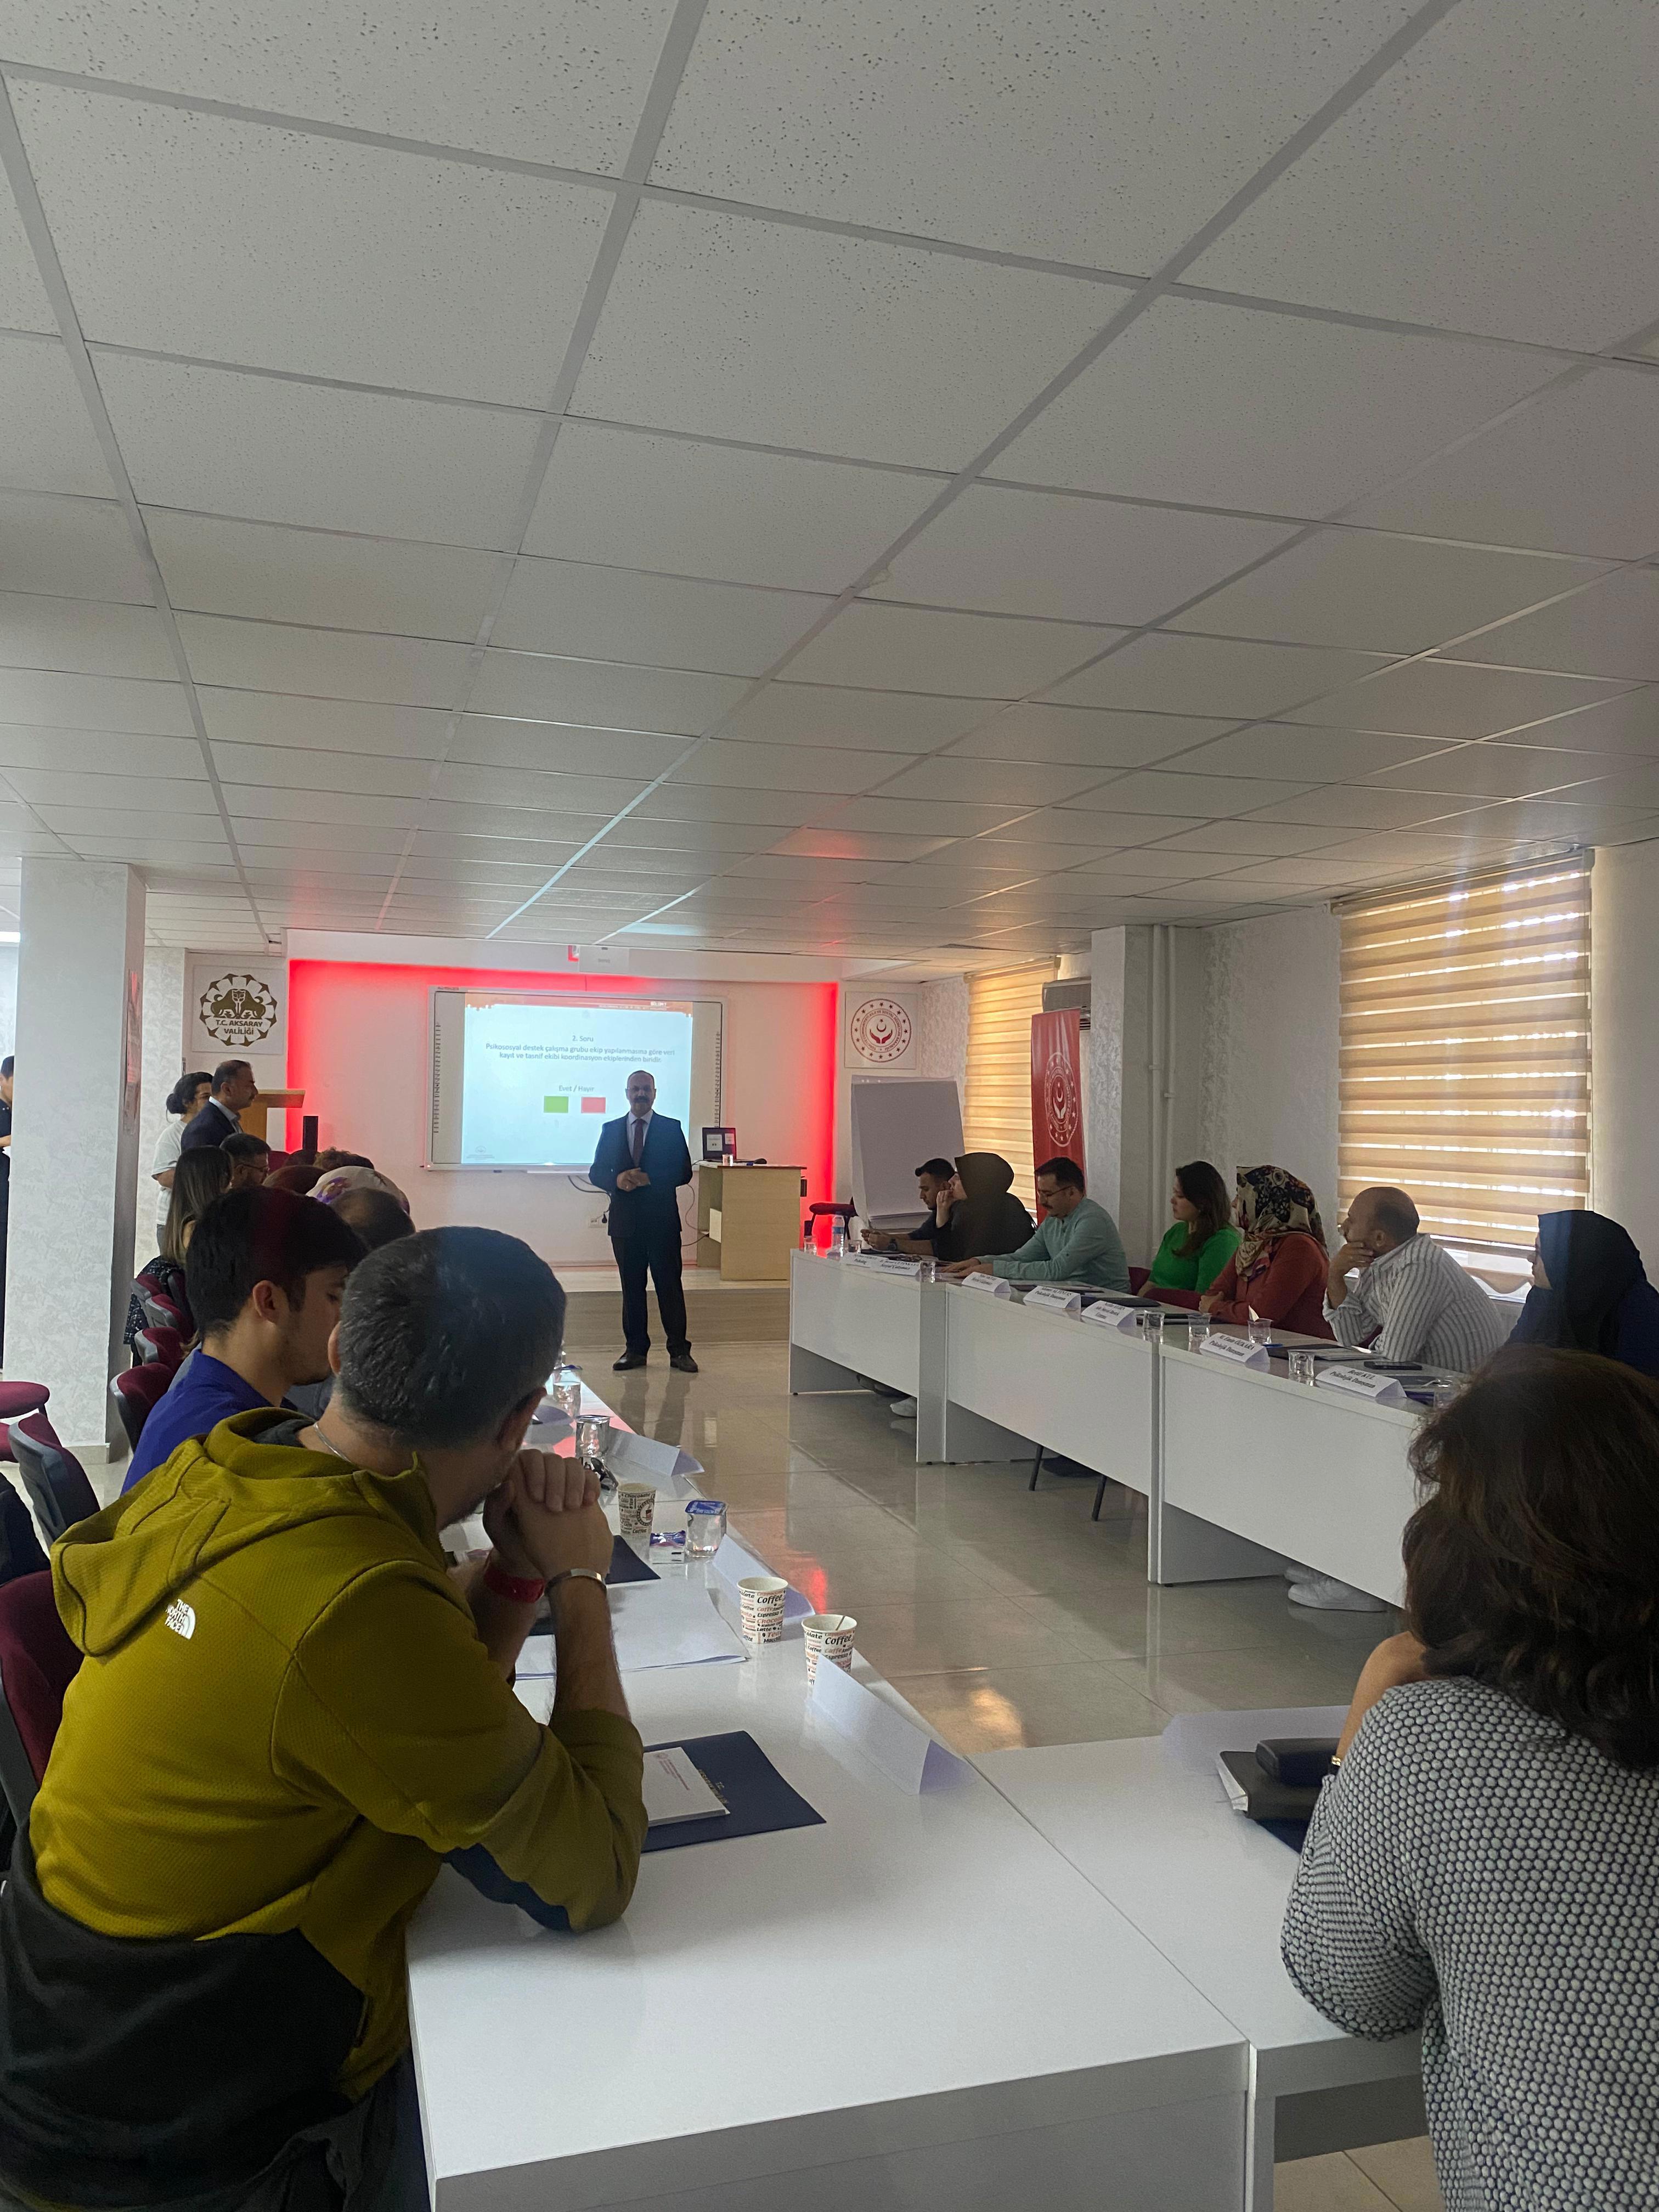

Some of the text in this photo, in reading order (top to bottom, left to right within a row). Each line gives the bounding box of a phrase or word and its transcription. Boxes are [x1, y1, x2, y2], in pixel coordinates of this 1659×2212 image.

[486, 1043, 522, 1052] Psikososyal
[545, 1045, 569, 1053] çalışma
[561, 1053, 602, 1062] koordinasyon
[757, 1594, 783, 1604] Coffee
[825, 1634, 852, 1645] Coffee
